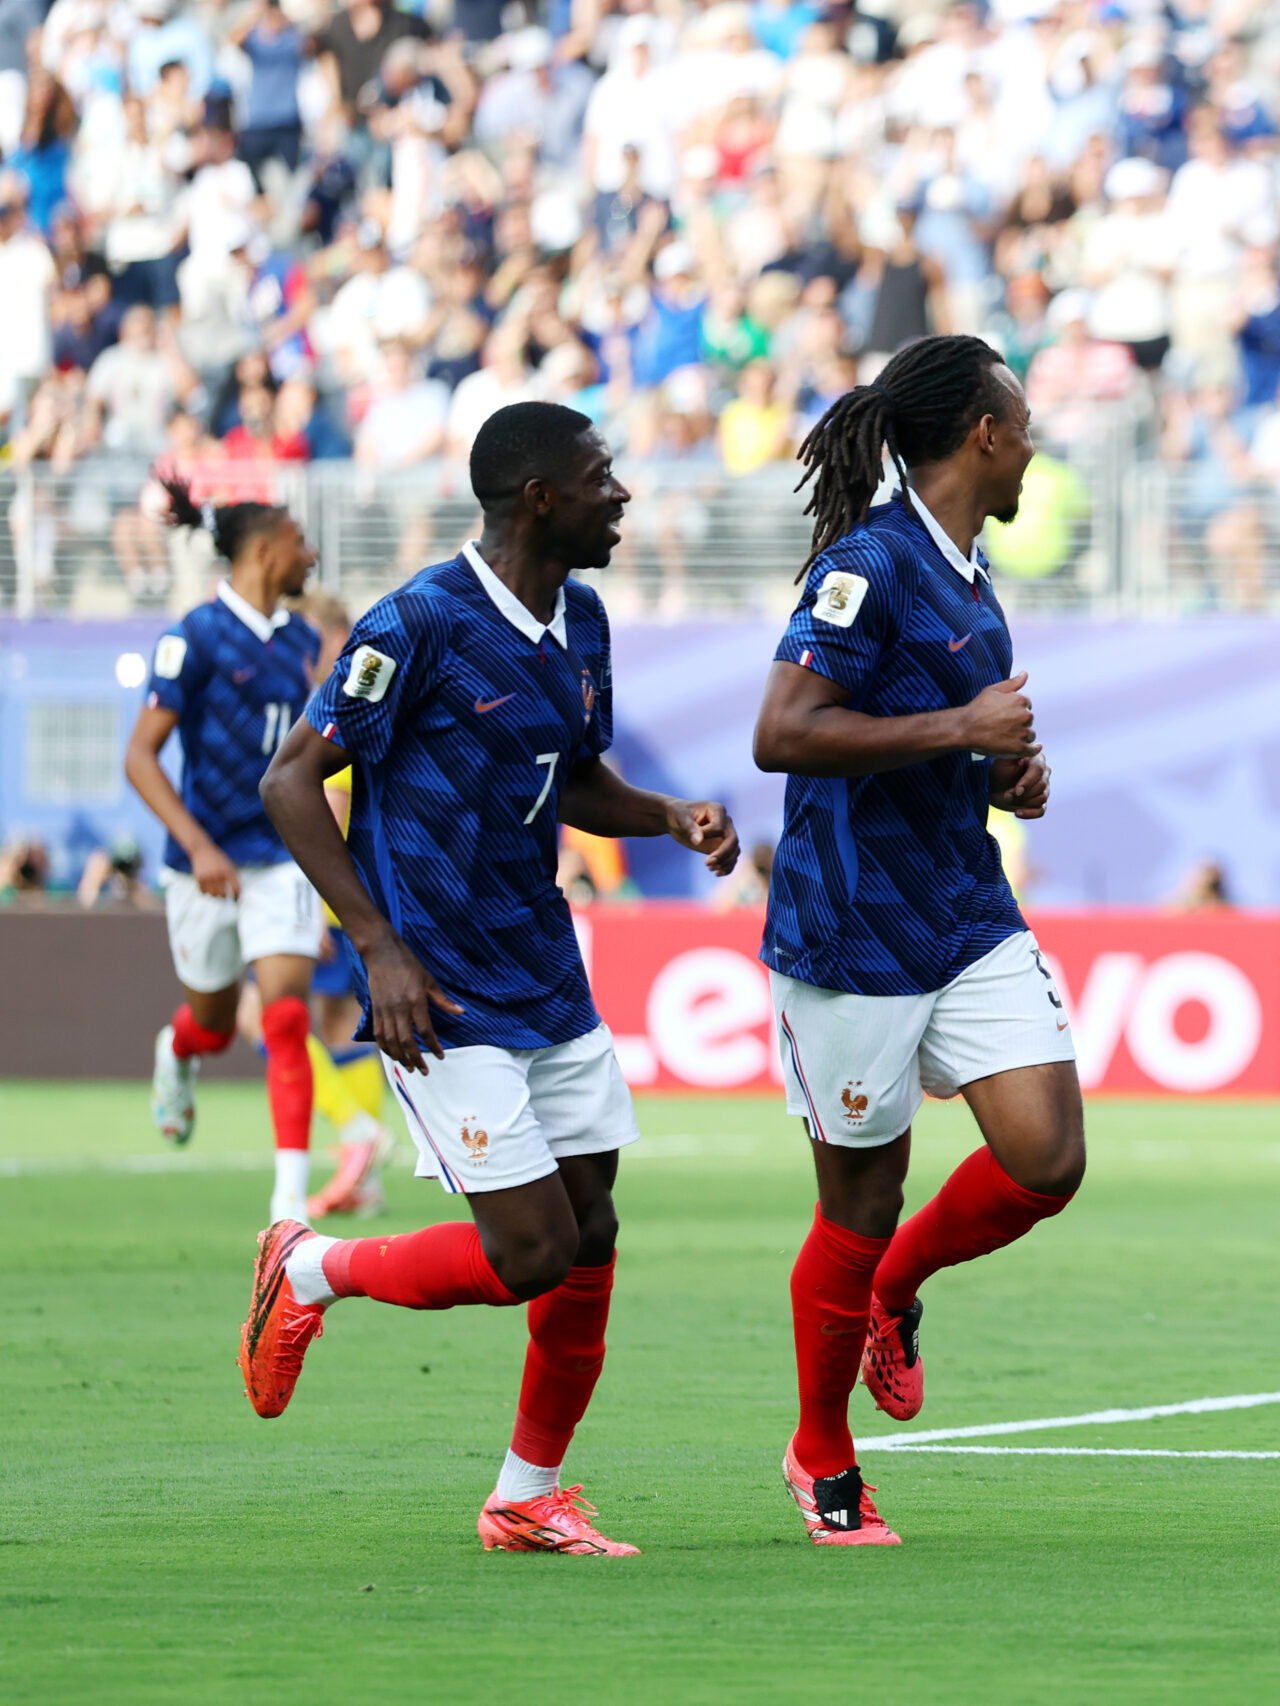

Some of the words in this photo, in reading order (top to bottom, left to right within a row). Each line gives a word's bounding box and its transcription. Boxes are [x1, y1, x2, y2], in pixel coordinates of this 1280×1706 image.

[262, 702, 291, 756] 11
[523, 752, 560, 825] 7
[573, 911, 1263, 1093] evo
